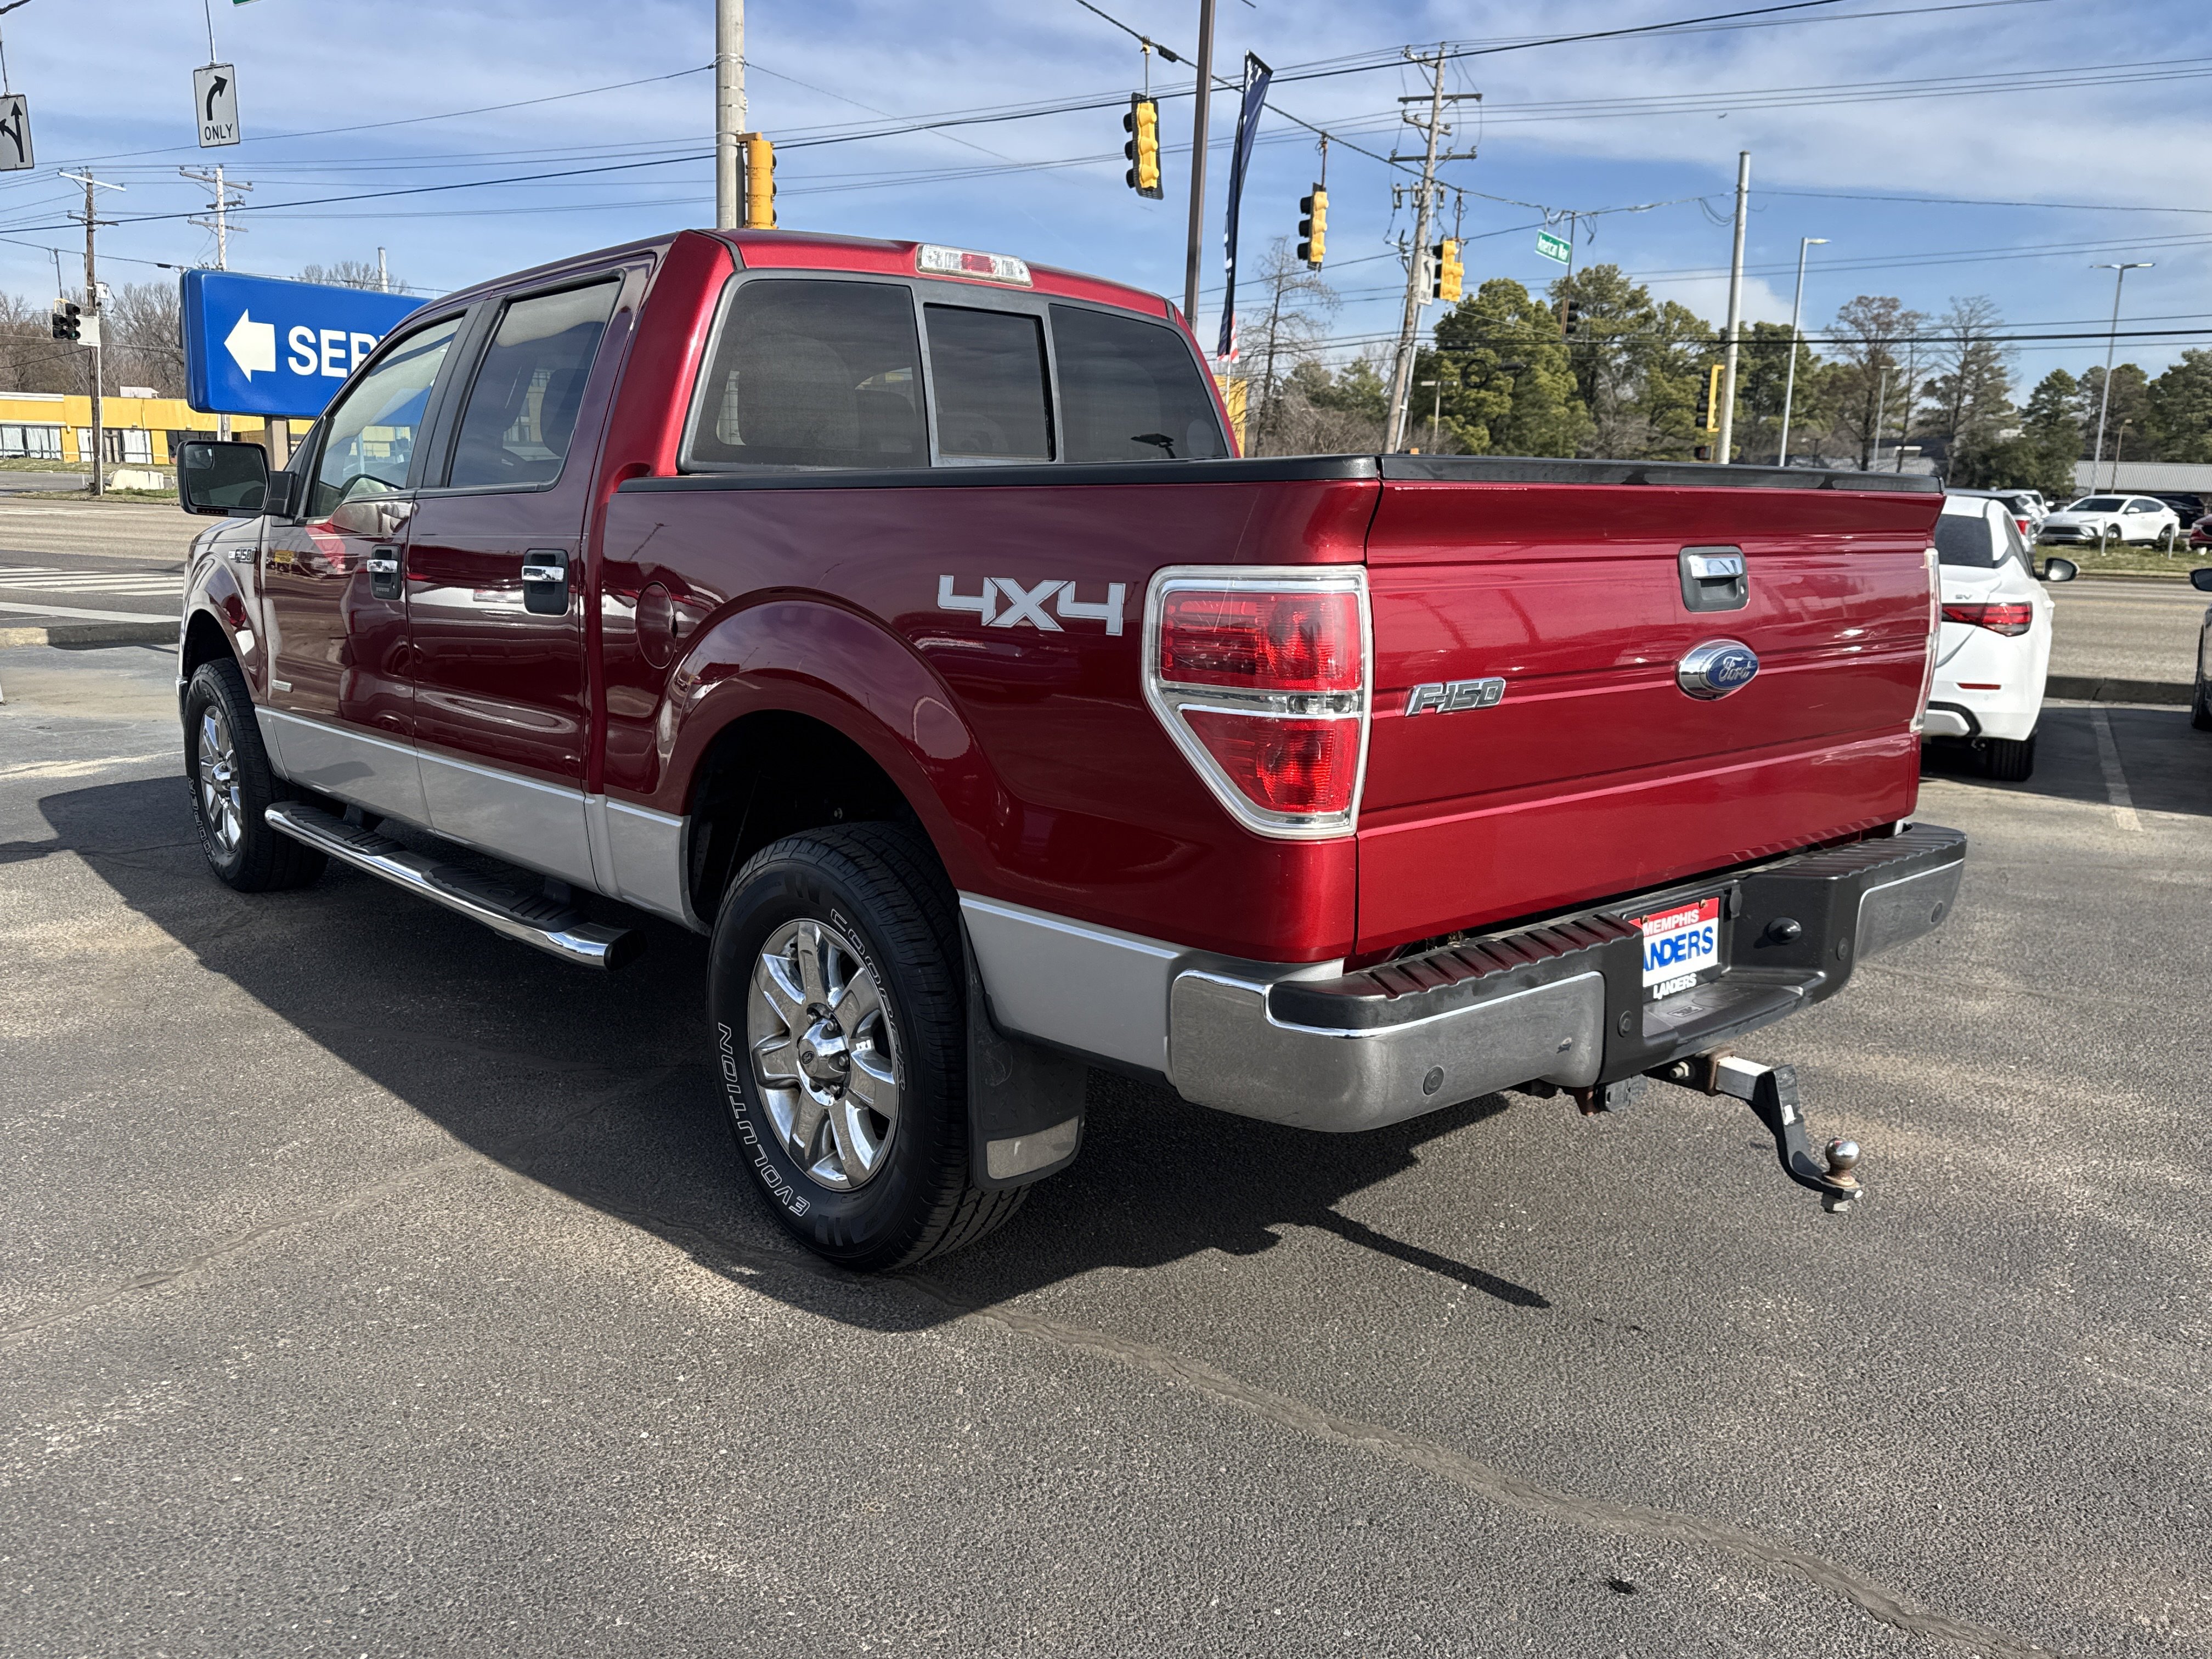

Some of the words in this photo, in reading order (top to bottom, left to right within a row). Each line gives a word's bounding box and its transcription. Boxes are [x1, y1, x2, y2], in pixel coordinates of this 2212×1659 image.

[205, 123, 232, 140] ONLY
[288, 325, 385, 377] SER
[1718, 656, 1752, 682] Ford
[1404, 676, 1506, 718] F-150
[1643, 909, 1700, 937] MEMPHIS
[830, 909, 906, 1091] COOPER
[1653, 973, 1697, 1000] LANDERS
[718, 1022, 811, 1217] EVOLUTION
